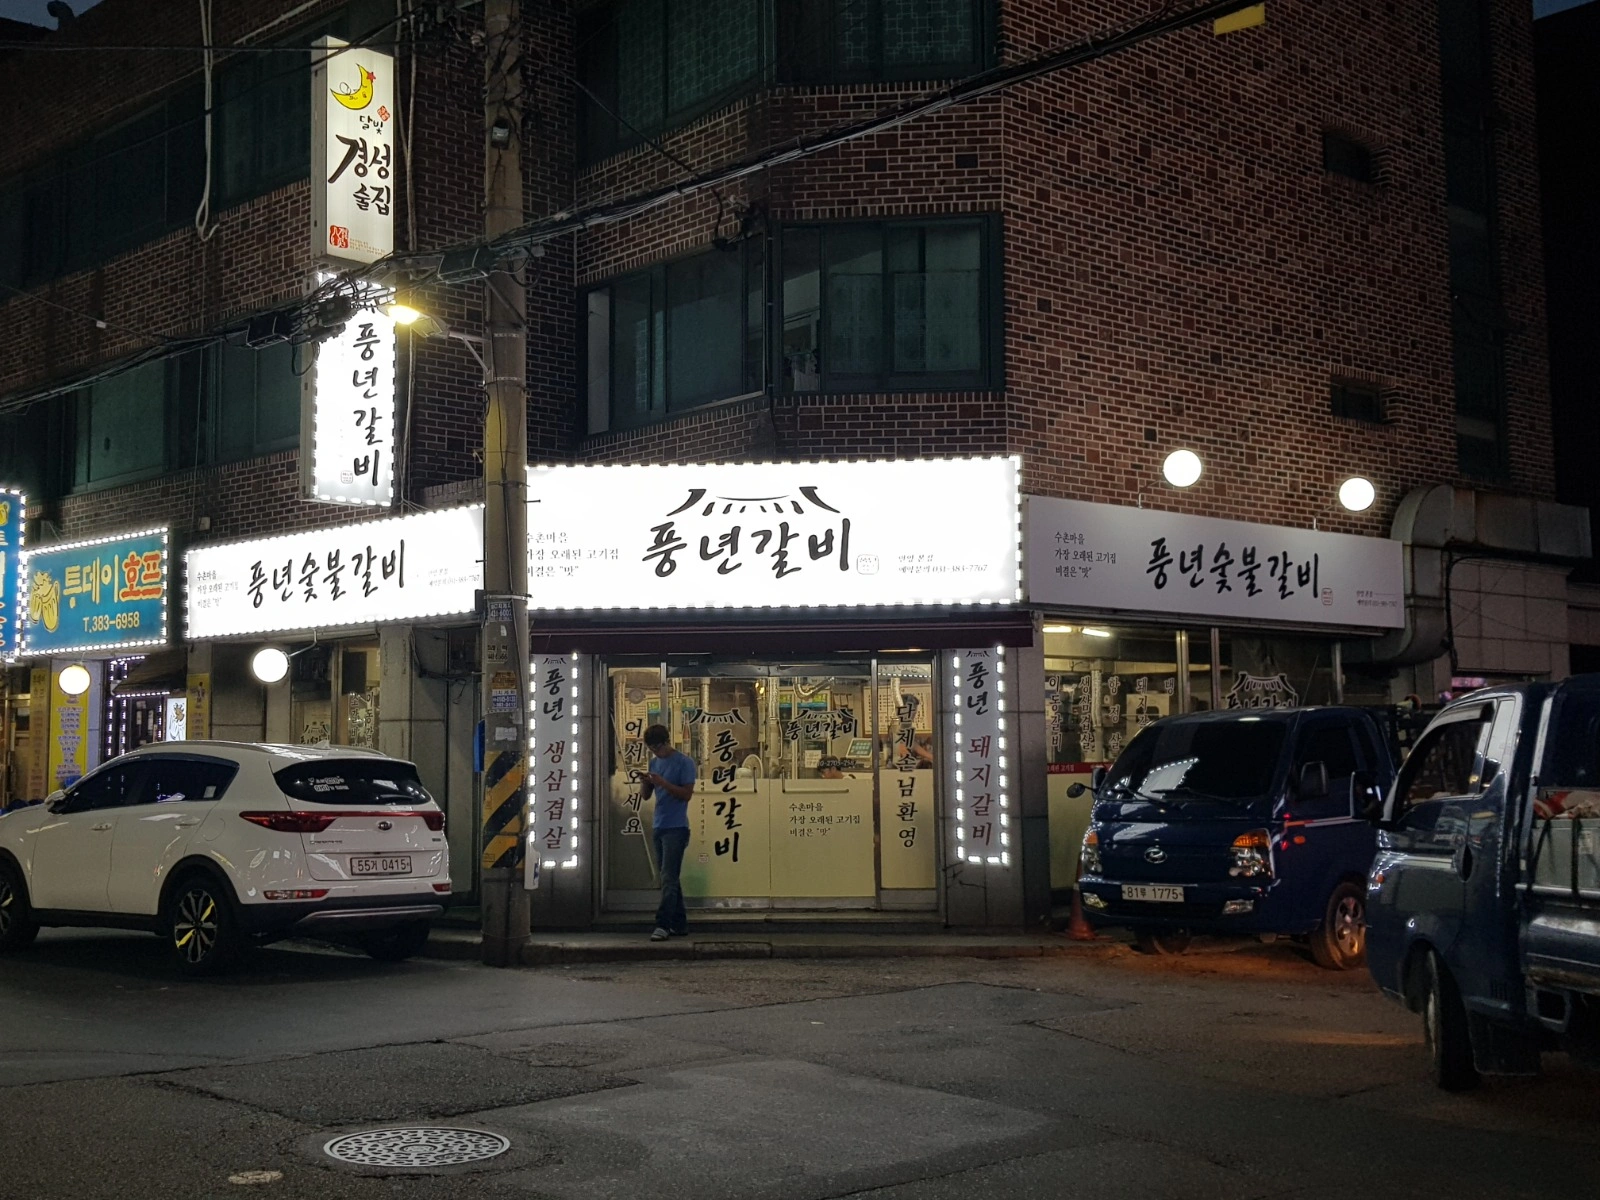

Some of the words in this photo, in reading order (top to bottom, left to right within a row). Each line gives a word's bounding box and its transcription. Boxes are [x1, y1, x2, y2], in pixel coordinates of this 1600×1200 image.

[359, 114, 384, 135] 달빛
[328, 134, 391, 184] 경성
[353, 183, 391, 216] 술집
[352, 322, 383, 487] 풍년갈비
[551, 548, 581, 560] 오래된
[587, 548, 619, 560] 고기집
[642, 517, 850, 579] 풍년갈비
[1055, 531, 1085, 545] 수촌마을
[1055, 548, 1070, 561] 가장
[1072, 550, 1094, 562] 오래된
[1096, 551, 1117, 564] 고기집
[247, 539, 405, 609] 풍년숯불갈비
[1055, 565, 1077, 578] 비결은
[1145, 536, 1320, 600] 풍년숯불갈비
[83, 611, 140, 633] T.383-6958
[542, 667, 566, 722] 풍년
[966, 661, 990, 716] 풍년
[1048, 675, 1063, 752] 이동갈비
[1079, 676, 1095, 752] 생삼겹살
[1107, 676, 1122, 750] 항정살
[1135, 677, 1151, 729] 돼지갈
[785, 717, 858, 742] 풍년갈비
[542, 740, 567, 850] 생삼겹살
[620, 717, 644, 835] 어서오세요
[712, 729, 742, 863] 풍년갈비
[968, 735, 995, 847] 돼지갈비
[788, 802, 824, 812] 수촌마을
[788, 815, 806, 825] 가장
[809, 815, 834, 824] 오래된
[836, 815, 861, 825] 고기집
[381, 858, 407, 871] 0415
[1152, 887, 1179, 900] 1775
